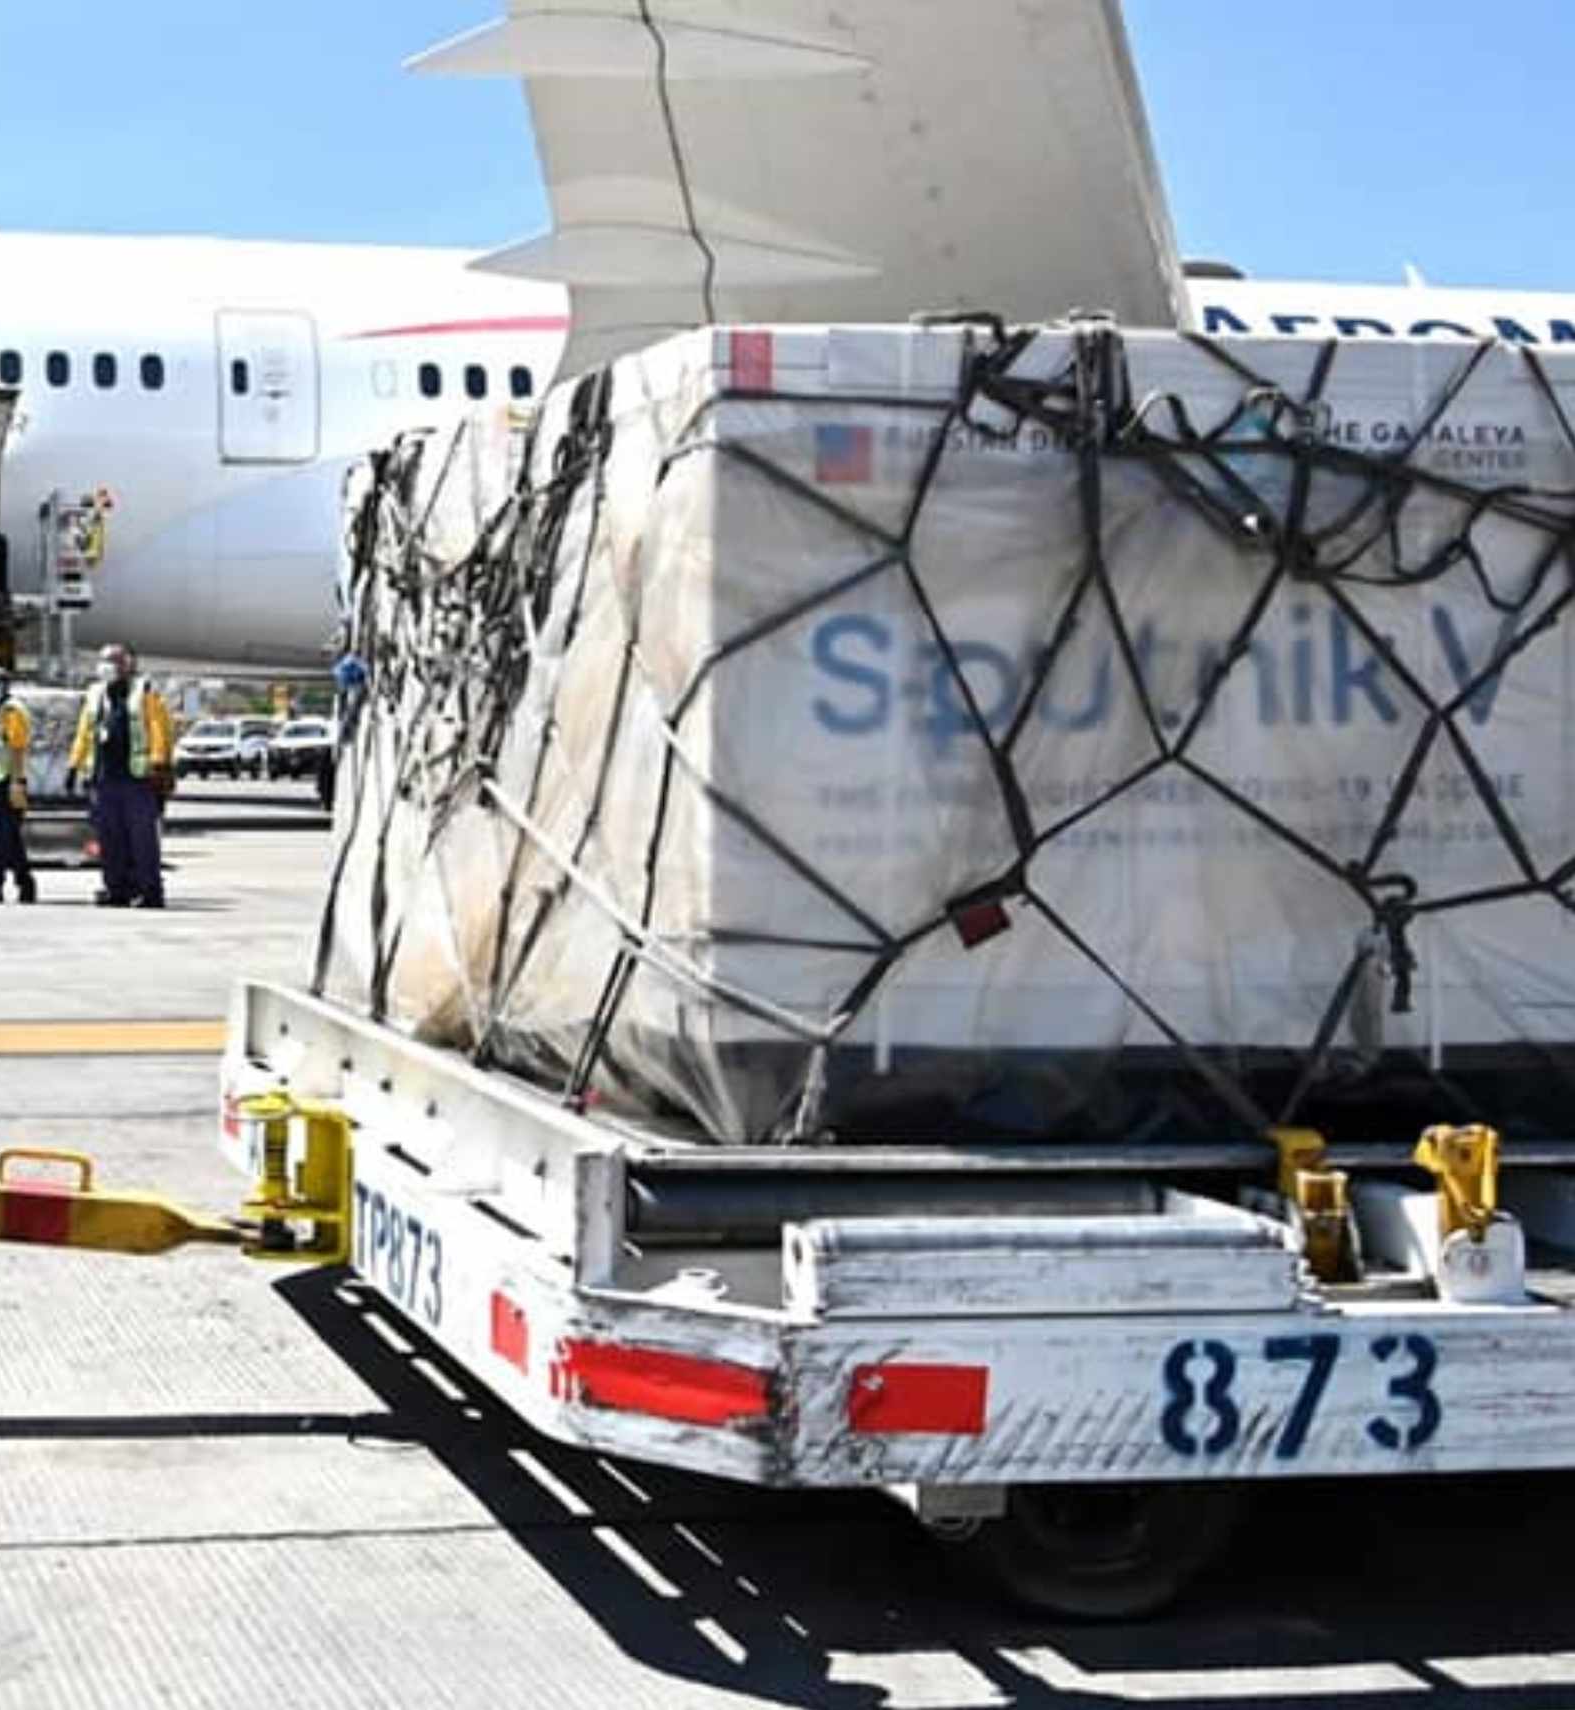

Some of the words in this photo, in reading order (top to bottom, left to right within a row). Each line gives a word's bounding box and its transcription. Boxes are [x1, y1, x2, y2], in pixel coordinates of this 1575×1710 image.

[1370, 421, 1525, 445] GAALEYA
[1434, 604, 1524, 726] V
[355, 1179, 443, 1328] TP873
[1160, 1332, 1443, 1459] 873
